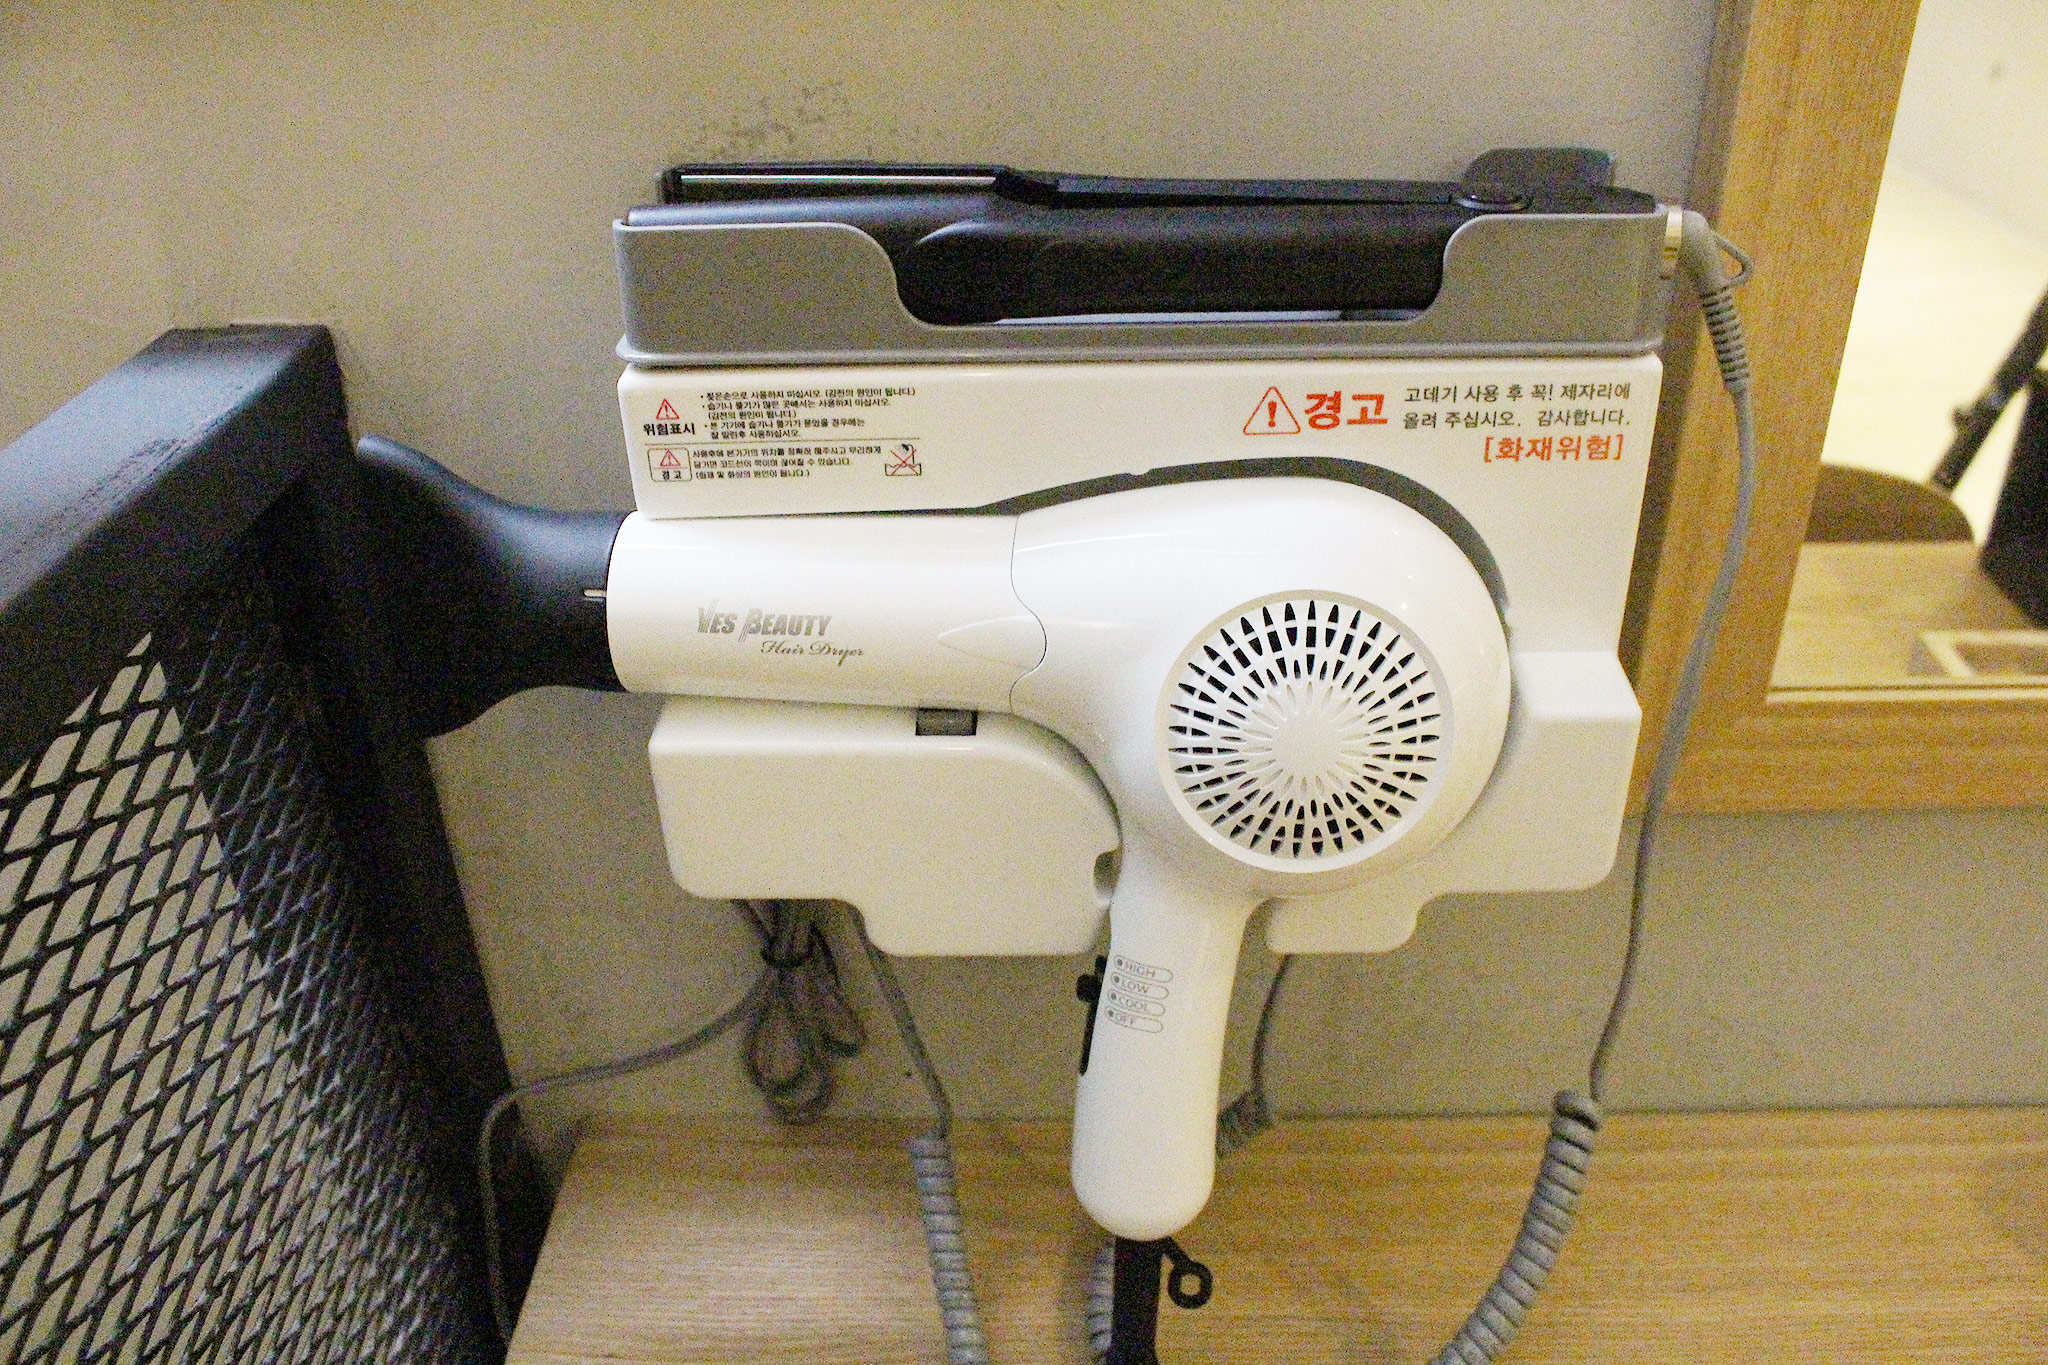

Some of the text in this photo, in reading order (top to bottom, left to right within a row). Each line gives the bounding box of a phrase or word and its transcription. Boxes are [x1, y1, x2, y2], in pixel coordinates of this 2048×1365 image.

[751, 390, 784, 399] 사용하지
[1404, 382, 1631, 403] 고데기 사용 후 꼭! 제자리에
[819, 399, 852, 408] 사용하지
[1304, 390, 1388, 430] 경고
[1403, 408, 1630, 429] 올려 주십시오. 감사합니다.
[643, 423, 695, 436] 위험표시
[1483, 434, 1624, 463] [화재위험]
[760, 640, 864, 667] Hair Dryer
[1124, 961, 1156, 978] HIGH
[1121, 980, 1150, 993] LOW
[1118, 996, 1149, 1012] COOL
[1115, 1013, 1135, 1025] OFF
